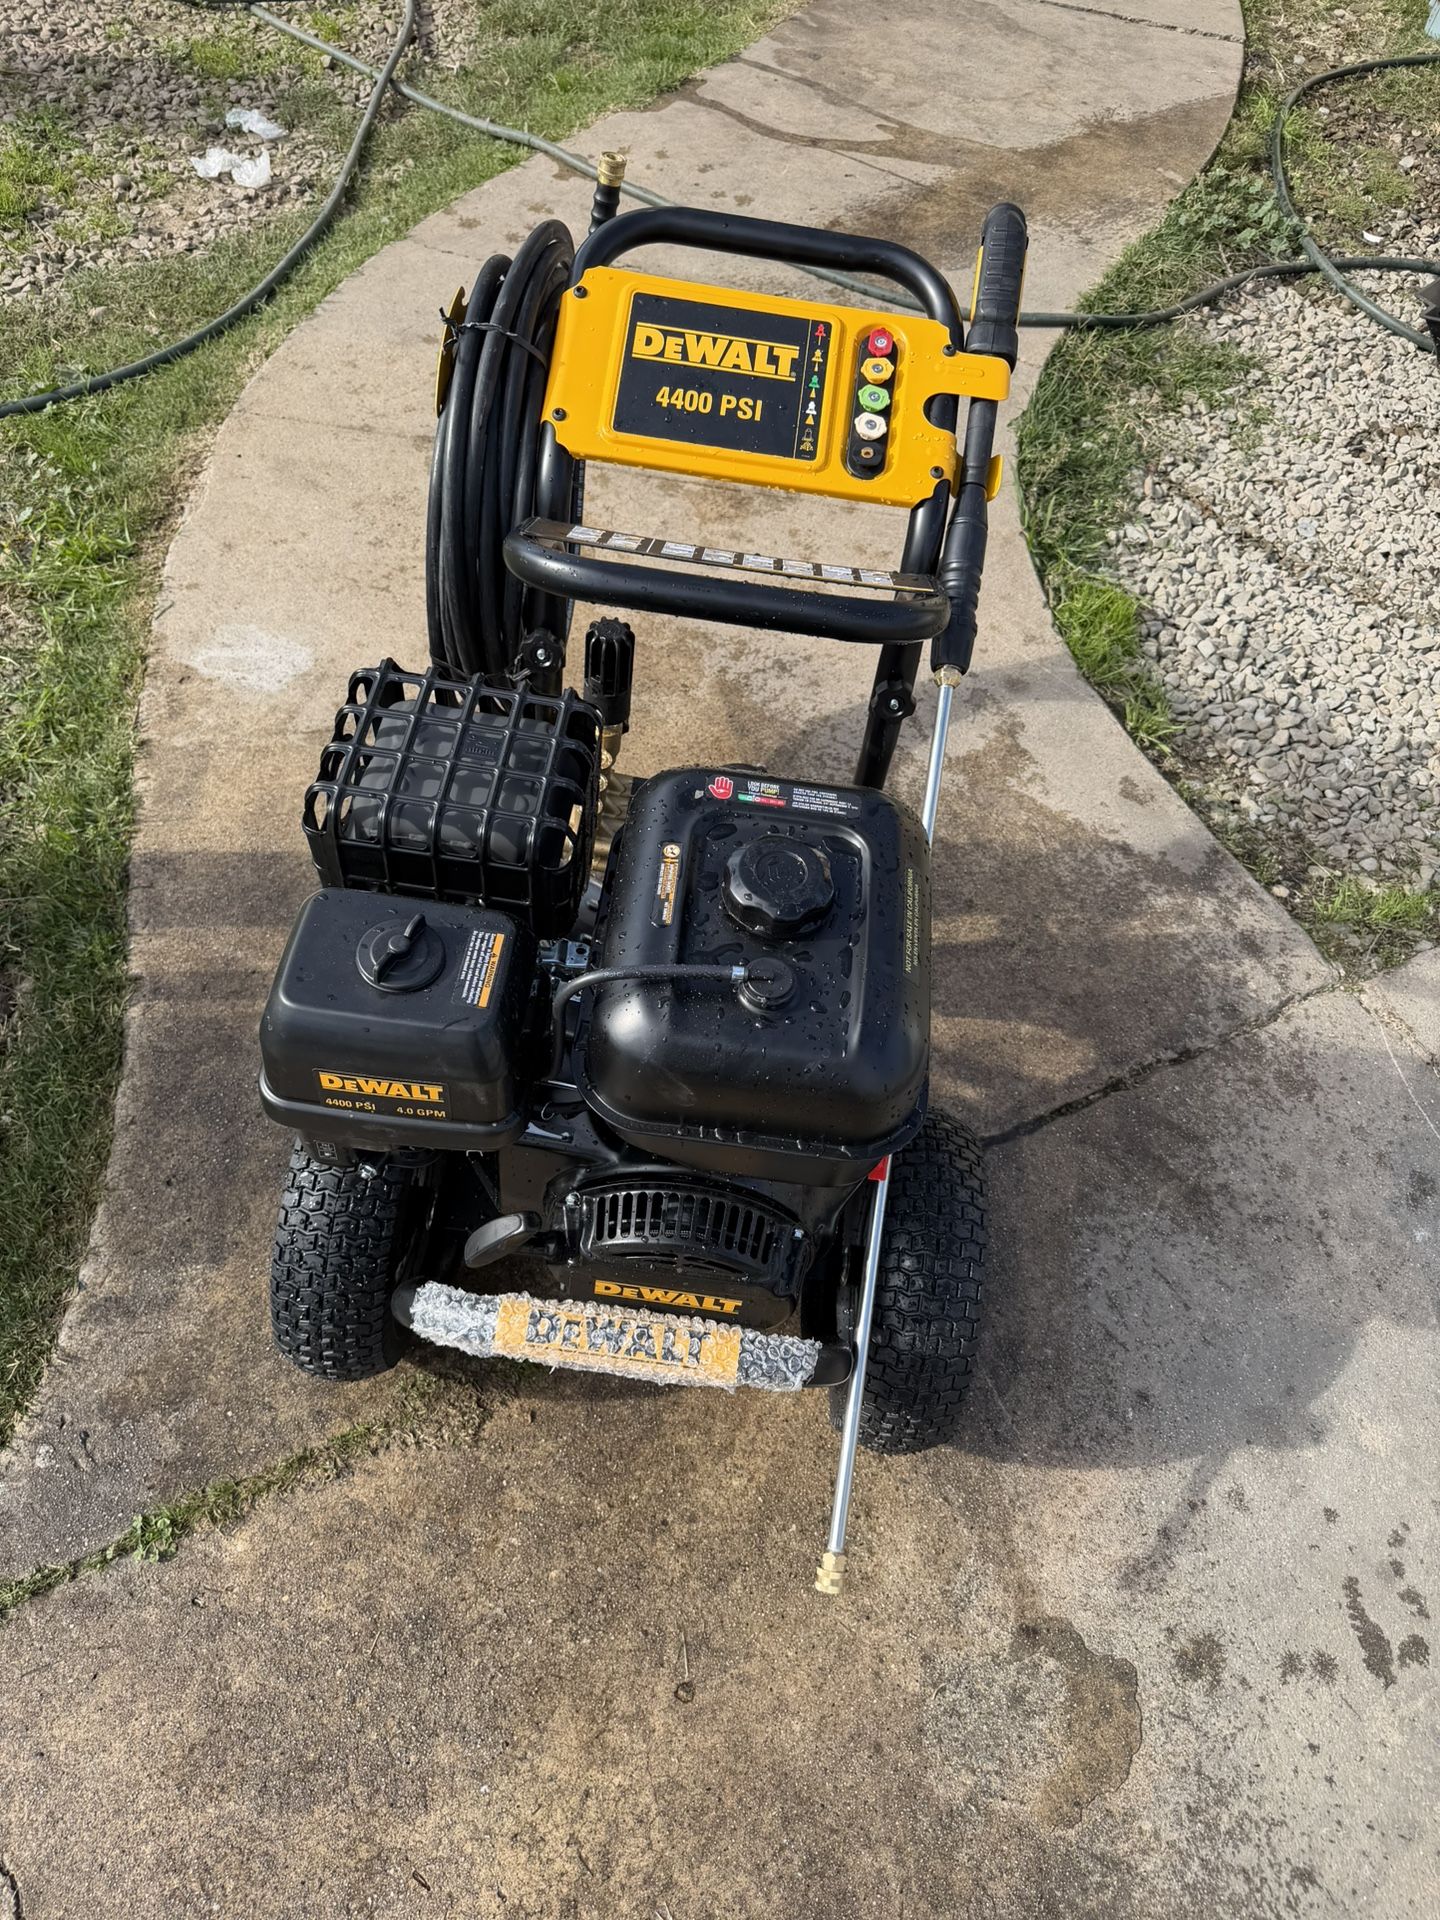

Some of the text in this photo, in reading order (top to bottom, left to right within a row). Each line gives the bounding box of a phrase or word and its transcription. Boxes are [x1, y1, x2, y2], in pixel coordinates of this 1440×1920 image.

[656, 386, 763, 422] 4400 PSI
[484, 959, 496, 988] WARNING
[325, 1097, 446, 1119] 4400 PSI 4.0 GPM
[596, 1280, 743, 1314] DEWALT
